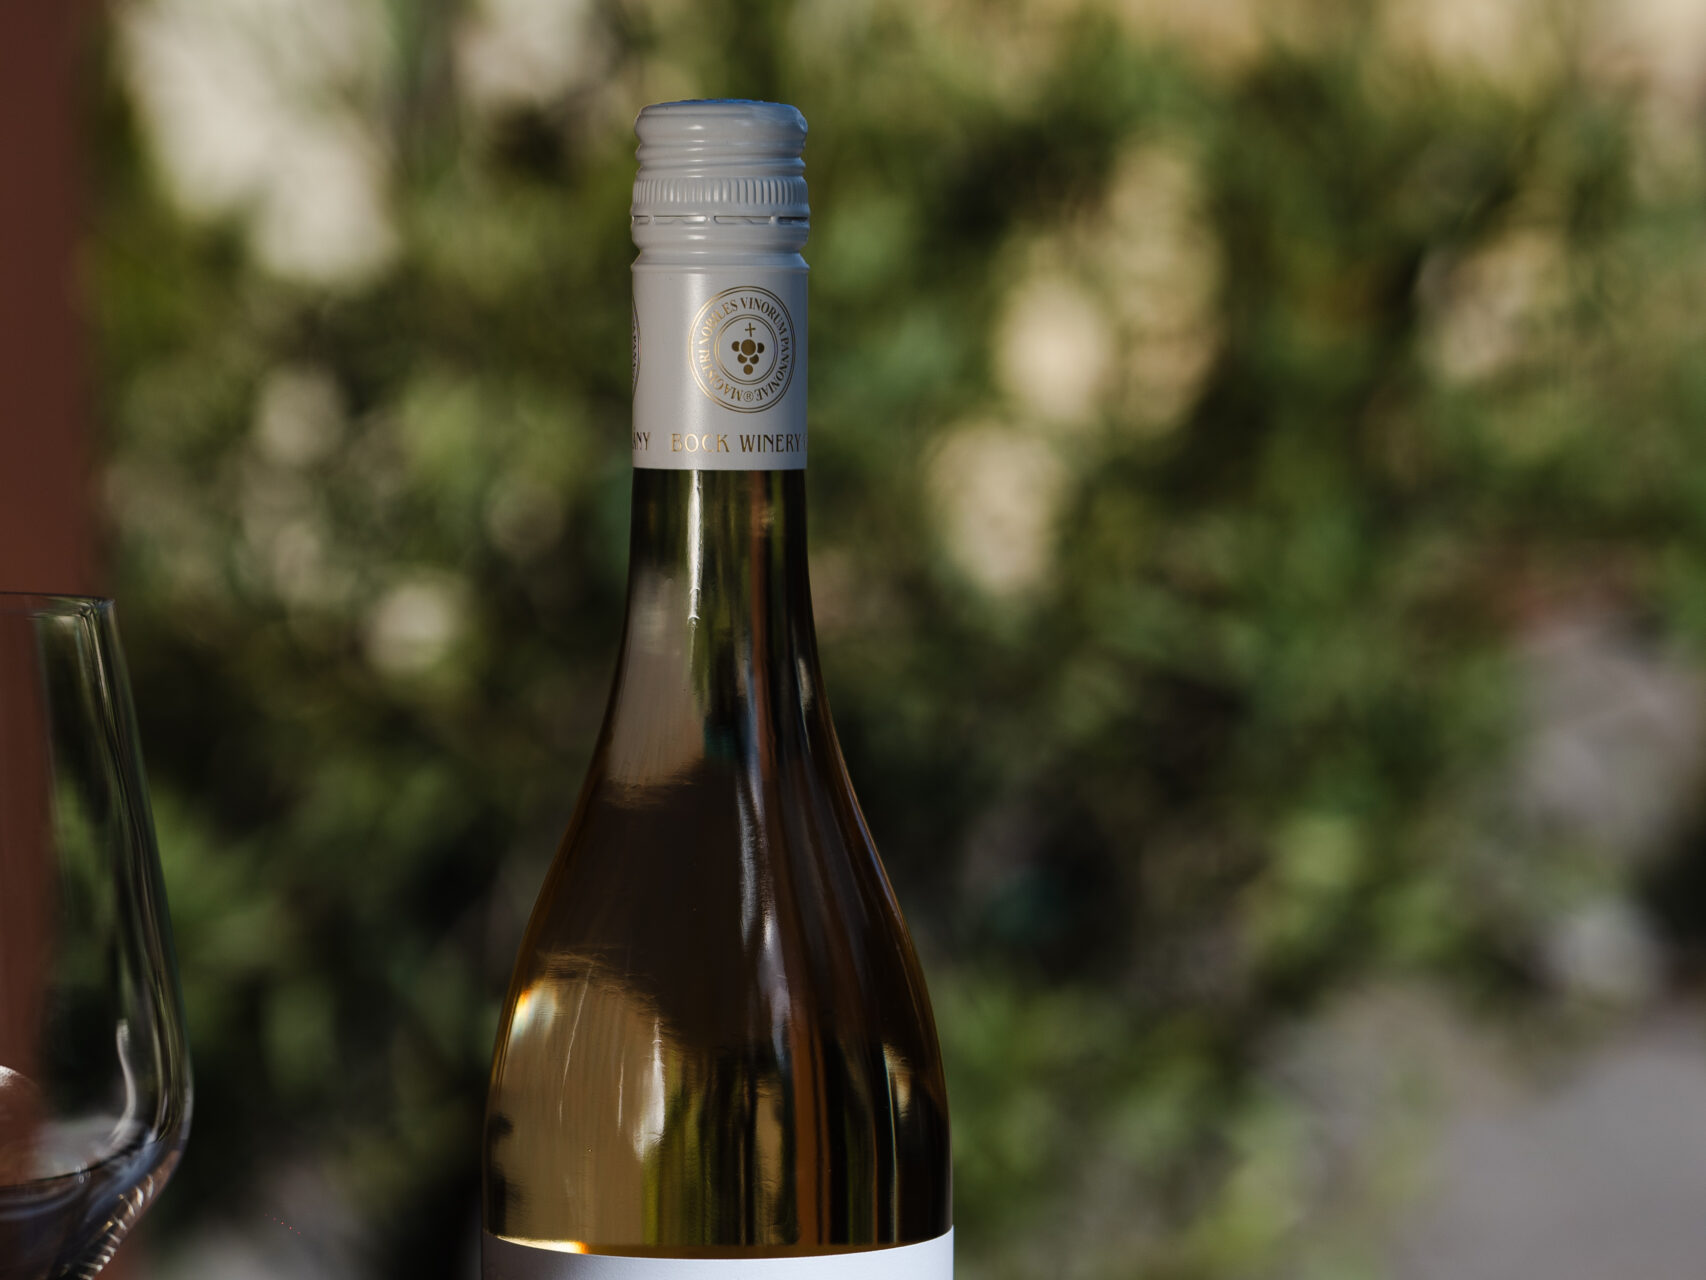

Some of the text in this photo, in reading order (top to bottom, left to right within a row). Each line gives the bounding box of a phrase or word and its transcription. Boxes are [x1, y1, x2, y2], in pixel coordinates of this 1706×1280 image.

[698, 299, 738, 347] NOBILES
[741, 297, 788, 336] VINORUM
[754, 337, 790, 401] PANNONIAE
[671, 433, 730, 453] BOCK
[739, 433, 801, 453] WINERY
